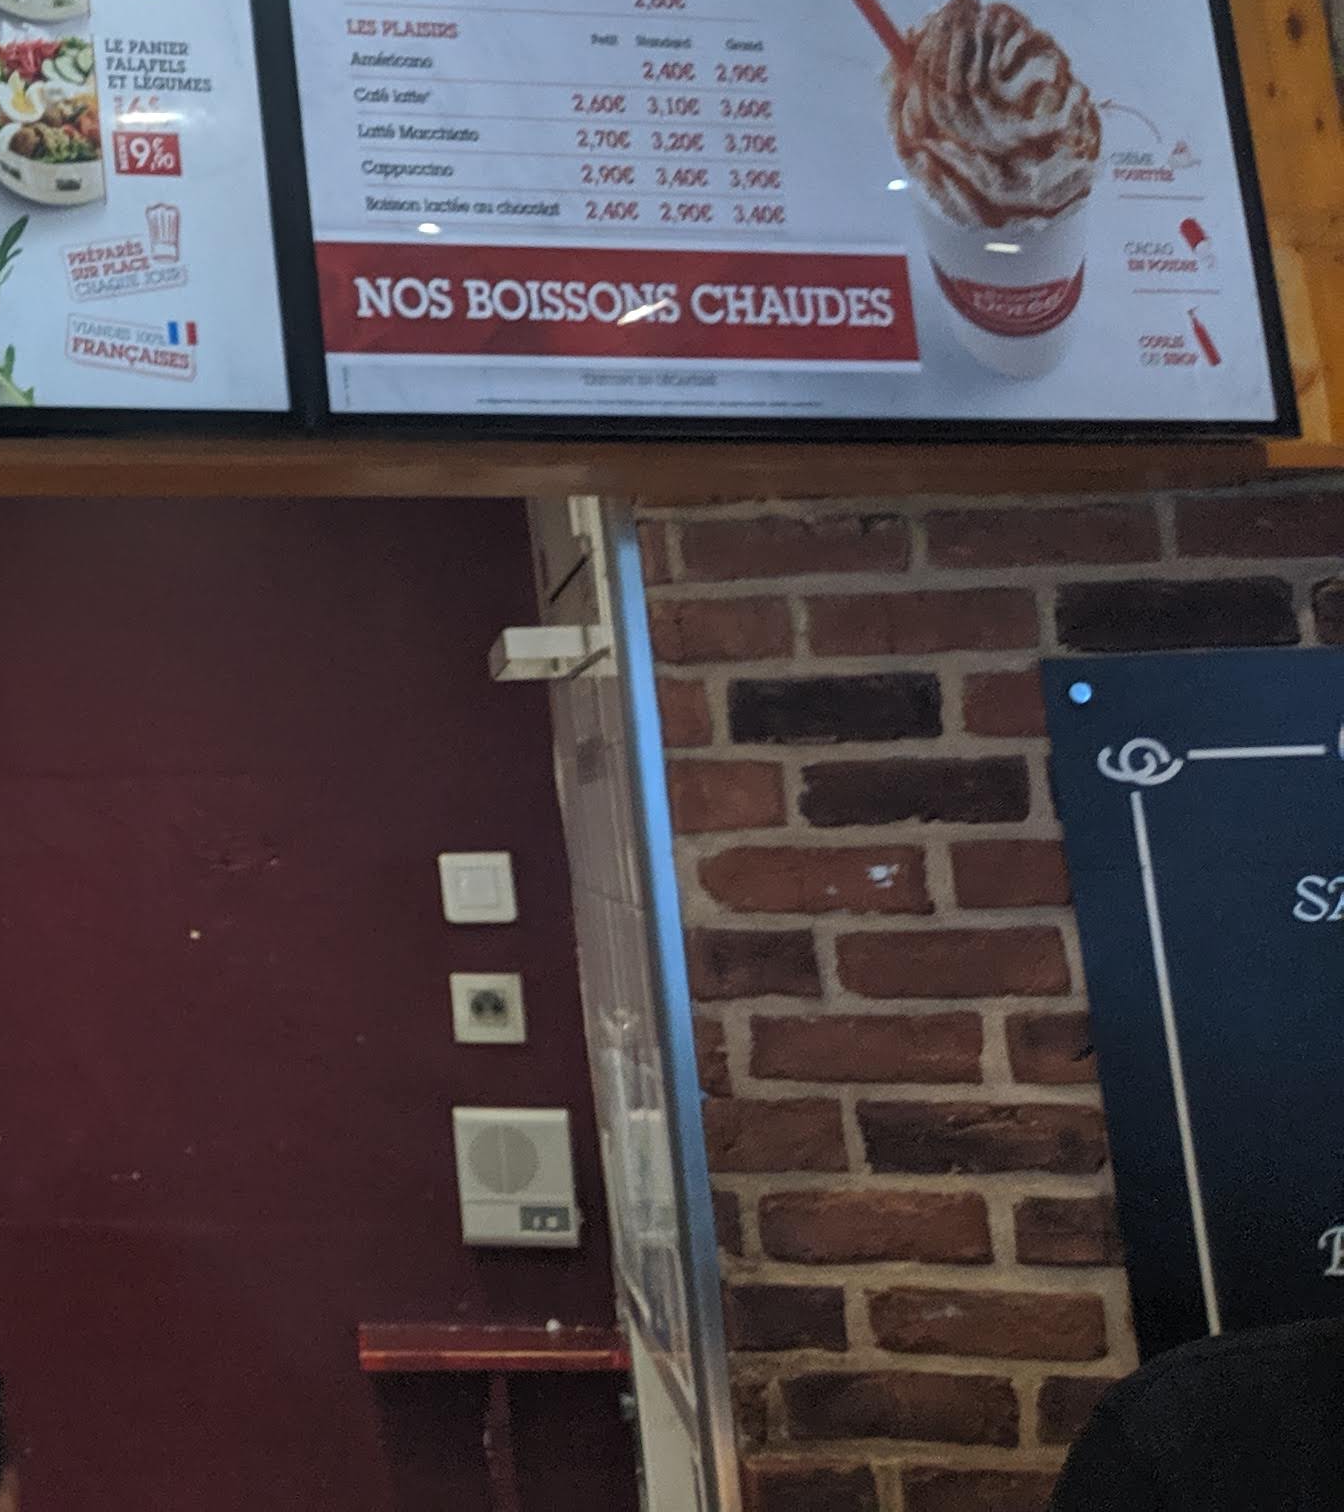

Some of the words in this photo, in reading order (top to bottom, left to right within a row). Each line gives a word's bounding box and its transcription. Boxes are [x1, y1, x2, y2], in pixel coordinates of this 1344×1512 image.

[105, 39, 123, 53] LE
[129, 40, 189, 55] PANIER
[106, 57, 186, 73] FALAFELS
[108, 74, 127, 89] ET
[354, 276, 454, 320] NOS
[464, 279, 678, 325] BOISSONS
[691, 282, 895, 329] CHAUDES
[72, 336, 190, 369] FRANÇAISES
